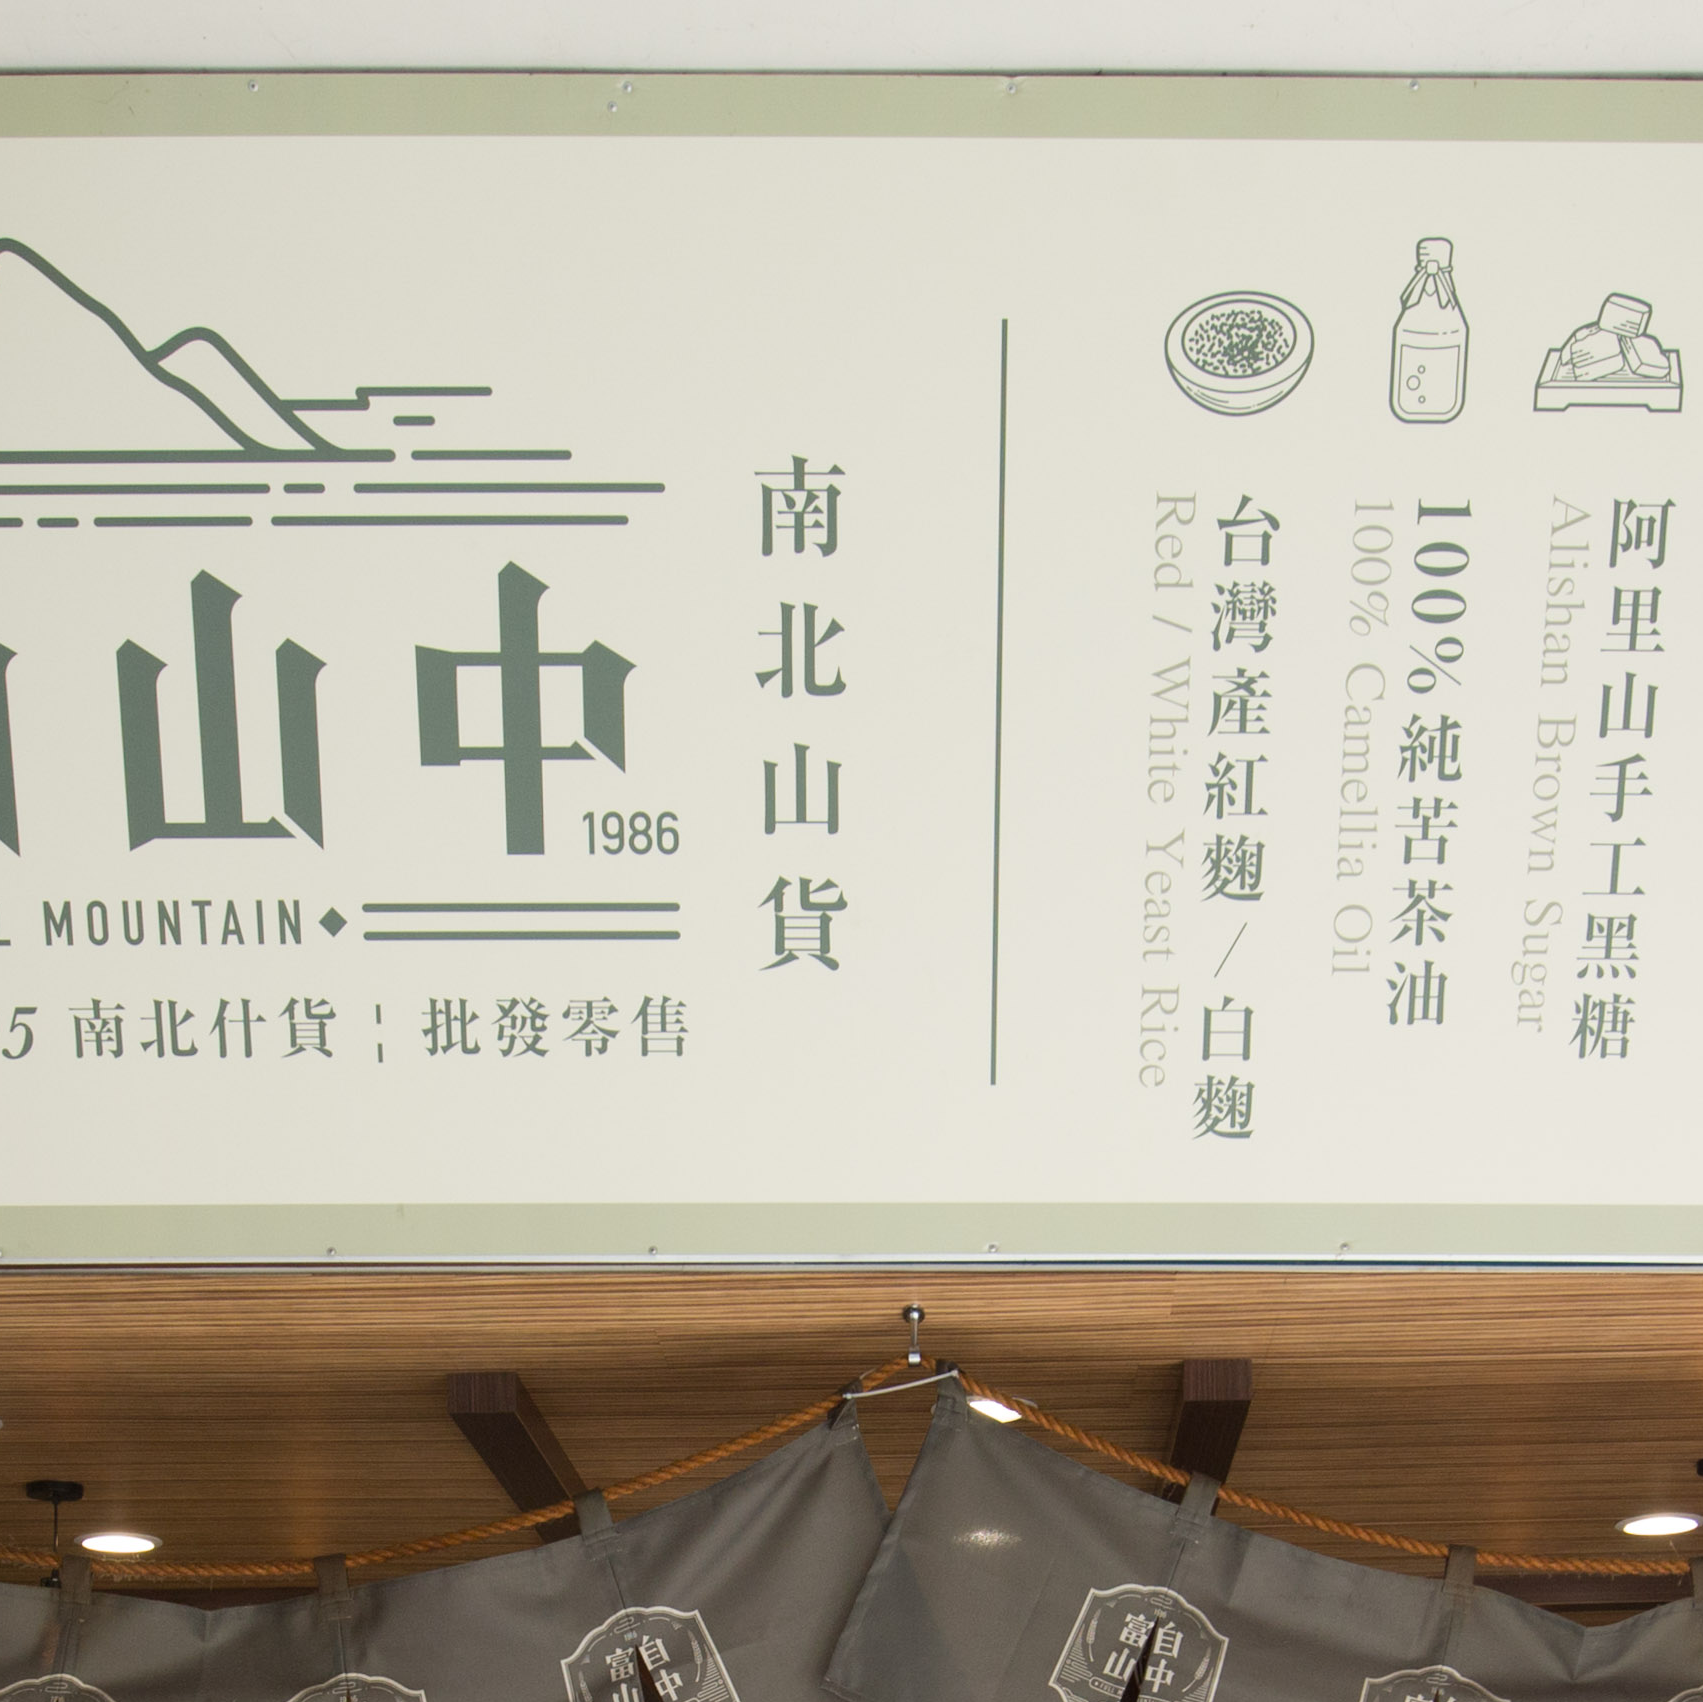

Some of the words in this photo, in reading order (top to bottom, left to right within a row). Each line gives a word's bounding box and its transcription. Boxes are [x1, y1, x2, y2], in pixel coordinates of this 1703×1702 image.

[1153, 491, 1197, 591] Red
[1348, 498, 1395, 636] 100%
[1540, 494, 1592, 687] Alishan
[753, 457, 848, 973] 南北山貨
[1146, 656, 1191, 805] White
[1336, 663, 1386, 881] Camellia
[1568, 498, 1676, 1059] 阿里山手工黑糖
[580, 809, 680, 857] 1986
[1527, 713, 1577, 874] Brown
[42, 900, 303, 948] MOUNTAIN
[1142, 828, 1185, 963] Yeast
[1331, 904, 1373, 976] Oil
[67, 999, 337, 1062] 南北什貨
[421, 997, 690, 1061] 批發零售
[1511, 900, 1563, 1033] Sugar
[1138, 984, 1180, 1088] Rice
